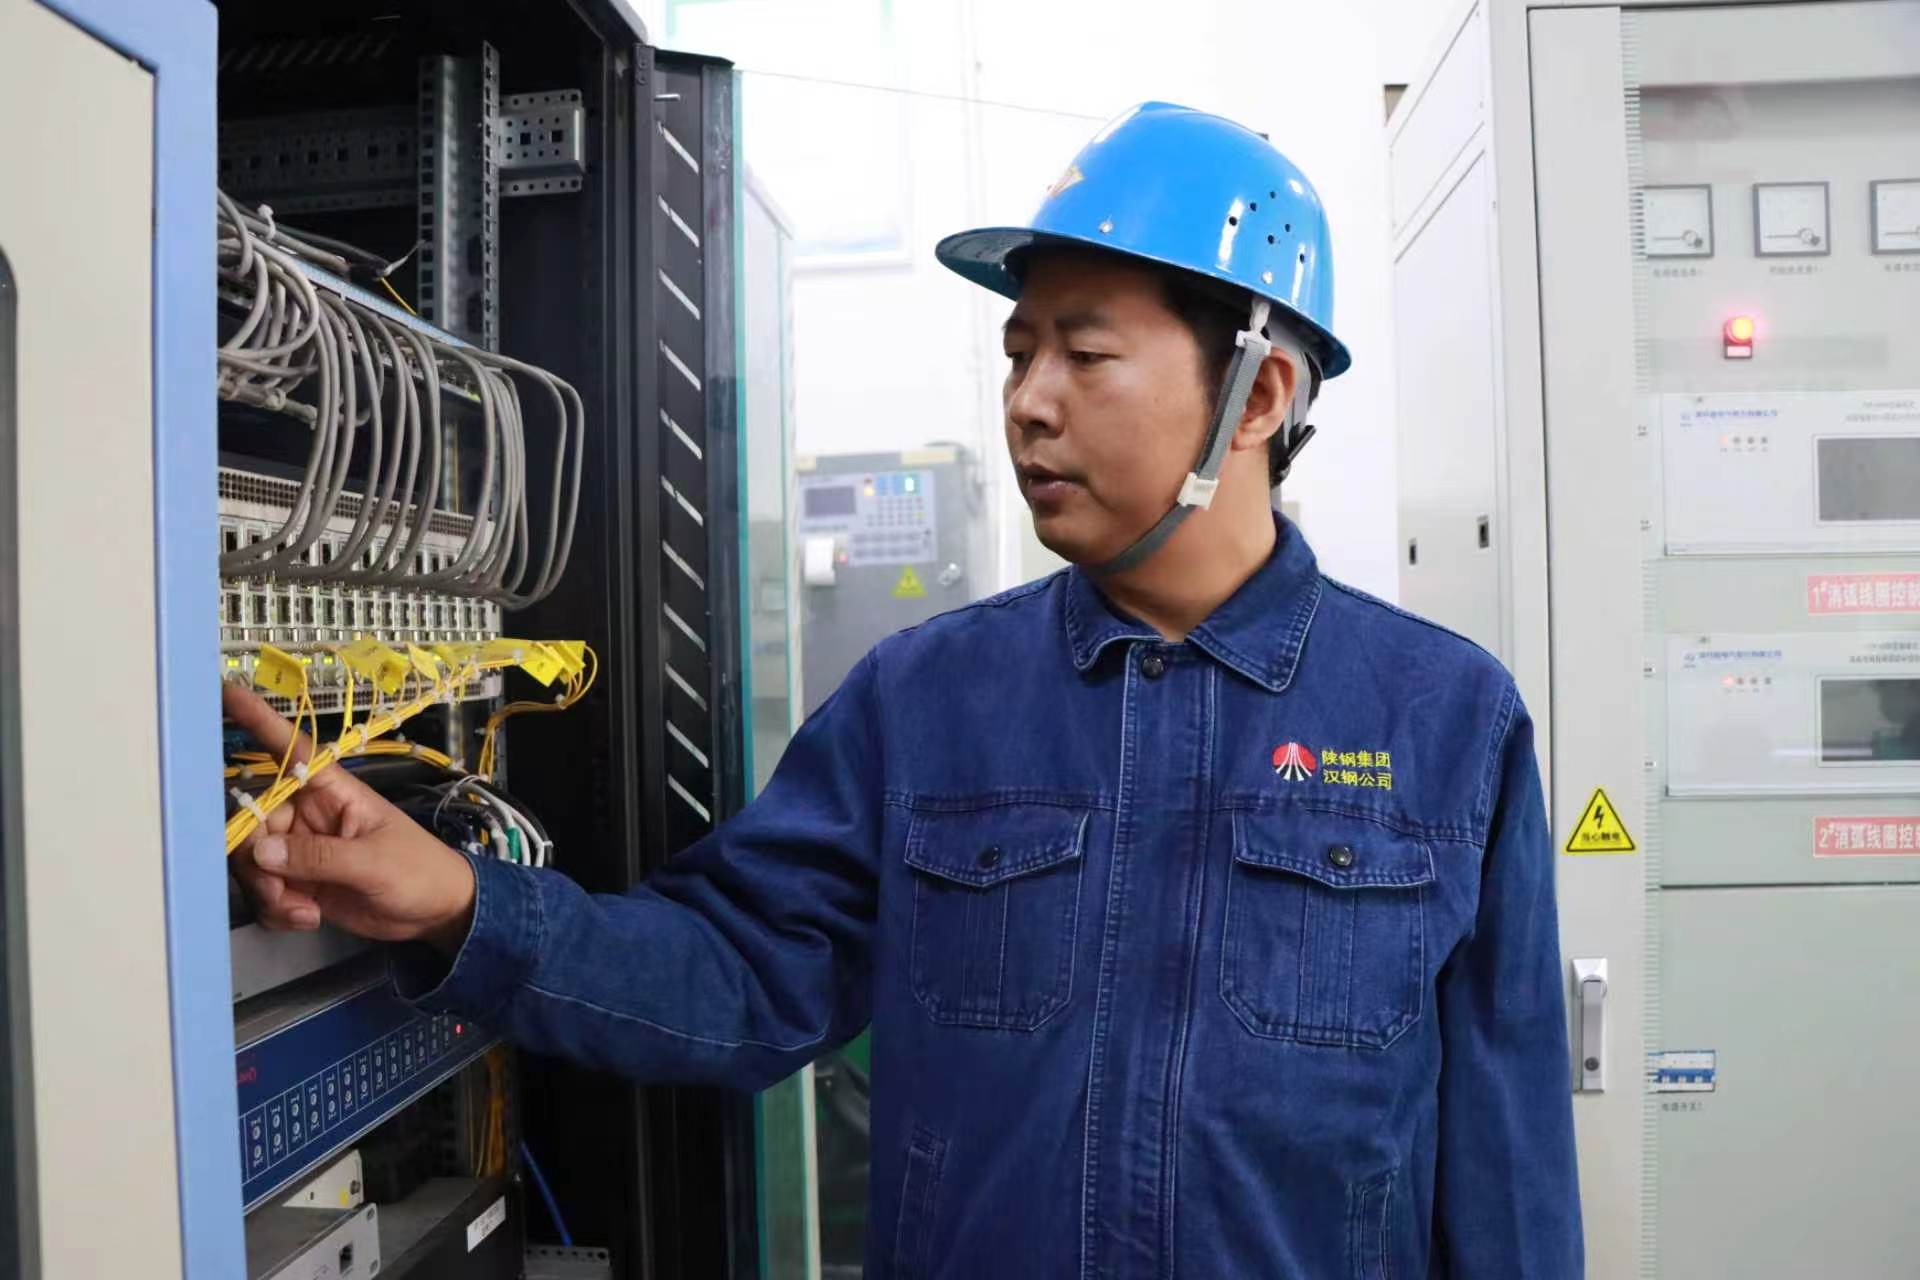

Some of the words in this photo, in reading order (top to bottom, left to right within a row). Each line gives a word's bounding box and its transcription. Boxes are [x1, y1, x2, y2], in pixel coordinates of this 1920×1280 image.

[1321, 749, 1391, 768] 陕钢集团
[1323, 769, 1392, 790] 汉钢公司
